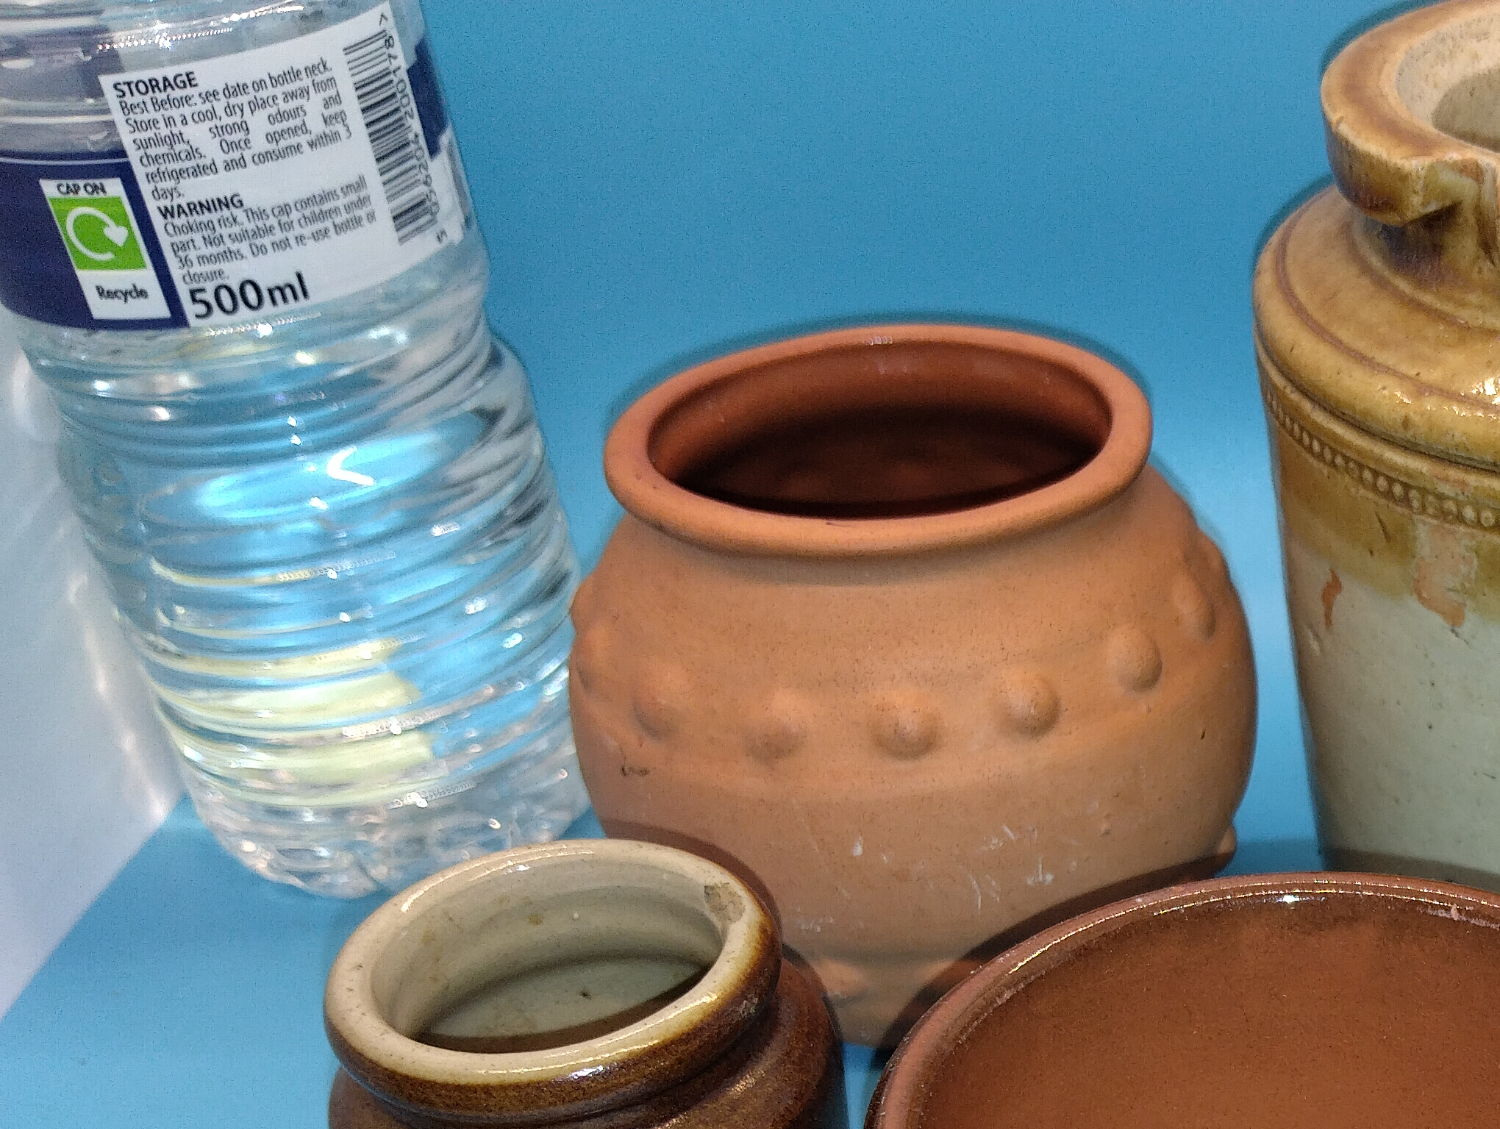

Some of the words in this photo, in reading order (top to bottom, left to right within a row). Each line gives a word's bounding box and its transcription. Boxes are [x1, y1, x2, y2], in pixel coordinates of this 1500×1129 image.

[113, 71, 198, 98] STORAGE
[119, 99, 150, 116] Best
[151, 94, 197, 113] Before:
[199, 89, 220, 105] see
[223, 82, 250, 100] date
[252, 77, 268, 92] on
[267, 66, 304, 88] bottle
[304, 57, 332, 78] neck.
[125, 118, 160, 135] Store
[162, 114, 177, 129] in
[180, 115, 188, 126] a
[191, 105, 222, 123] cool,
[224, 100, 245, 119] dry
[249, 95, 279, 116] place
[282, 85, 310, 103] away
[312, 76, 338, 94] from
[133, 130, 190, 151] sunlight,
[209, 120, 250, 140] strong
[267, 105, 307, 126] odours
[322, 90, 342, 109] and
[139, 145, 206, 168] chemicals.
[219, 137, 251, 155] Once
[265, 121, 312, 146] opened,
[321, 110, 347, 130] keep
[145, 159, 218, 185] refrigerated
[223, 155, 247, 172] and
[251, 141, 303, 166] consume
[307, 128, 342, 150] within
[56, 182, 81, 196] CAP
[83, 181, 107, 196] ON
[151, 186, 185, 202] days.
[157, 193, 244, 220] WARNING
[164, 217, 217, 237] Choking
[218, 212, 243, 233] risk.
[245, 206, 270, 223] This
[271, 202, 292, 221] cap
[294, 189, 339, 211] contains
[341, 175, 368, 197] small
[170, 239, 200, 256] part.
[202, 232, 226, 248] Not
[229, 223, 276, 244] suitable
[278, 219, 294, 234] for
[299, 205, 342, 225] children
[344, 194, 372, 213] under
[177, 253, 194, 270] 36
[196, 247, 247, 266] months.
[250, 242, 268, 258] Do
[271, 236, 293, 251] not
[295, 227, 331, 246] re-use
[333, 216, 363, 237] bottle
[366, 209, 377, 225] or
[95, 283, 149, 304] Recycle
[182, 267, 229, 286] closure.
[188, 271, 310, 320] 500ml
